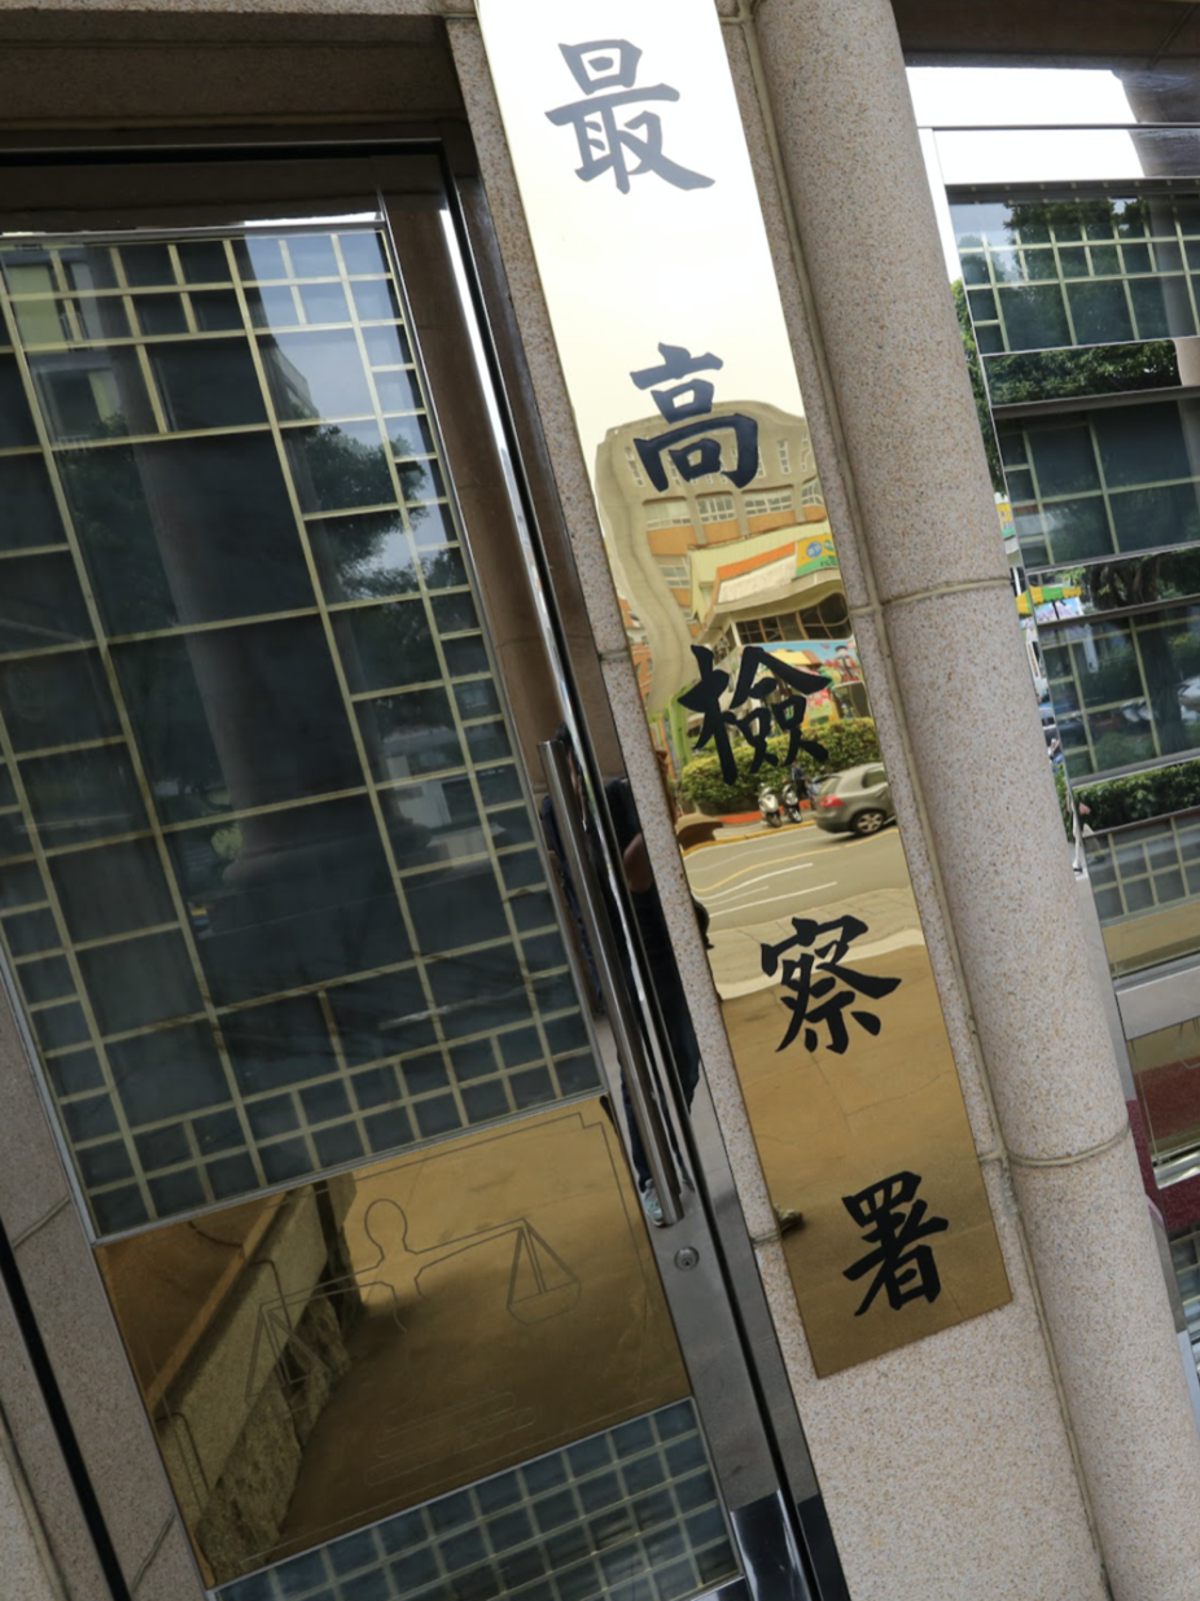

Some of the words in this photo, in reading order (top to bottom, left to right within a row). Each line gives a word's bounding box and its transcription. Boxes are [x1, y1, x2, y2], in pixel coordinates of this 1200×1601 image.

[544, 38, 949, 1317] 最高檢察署
